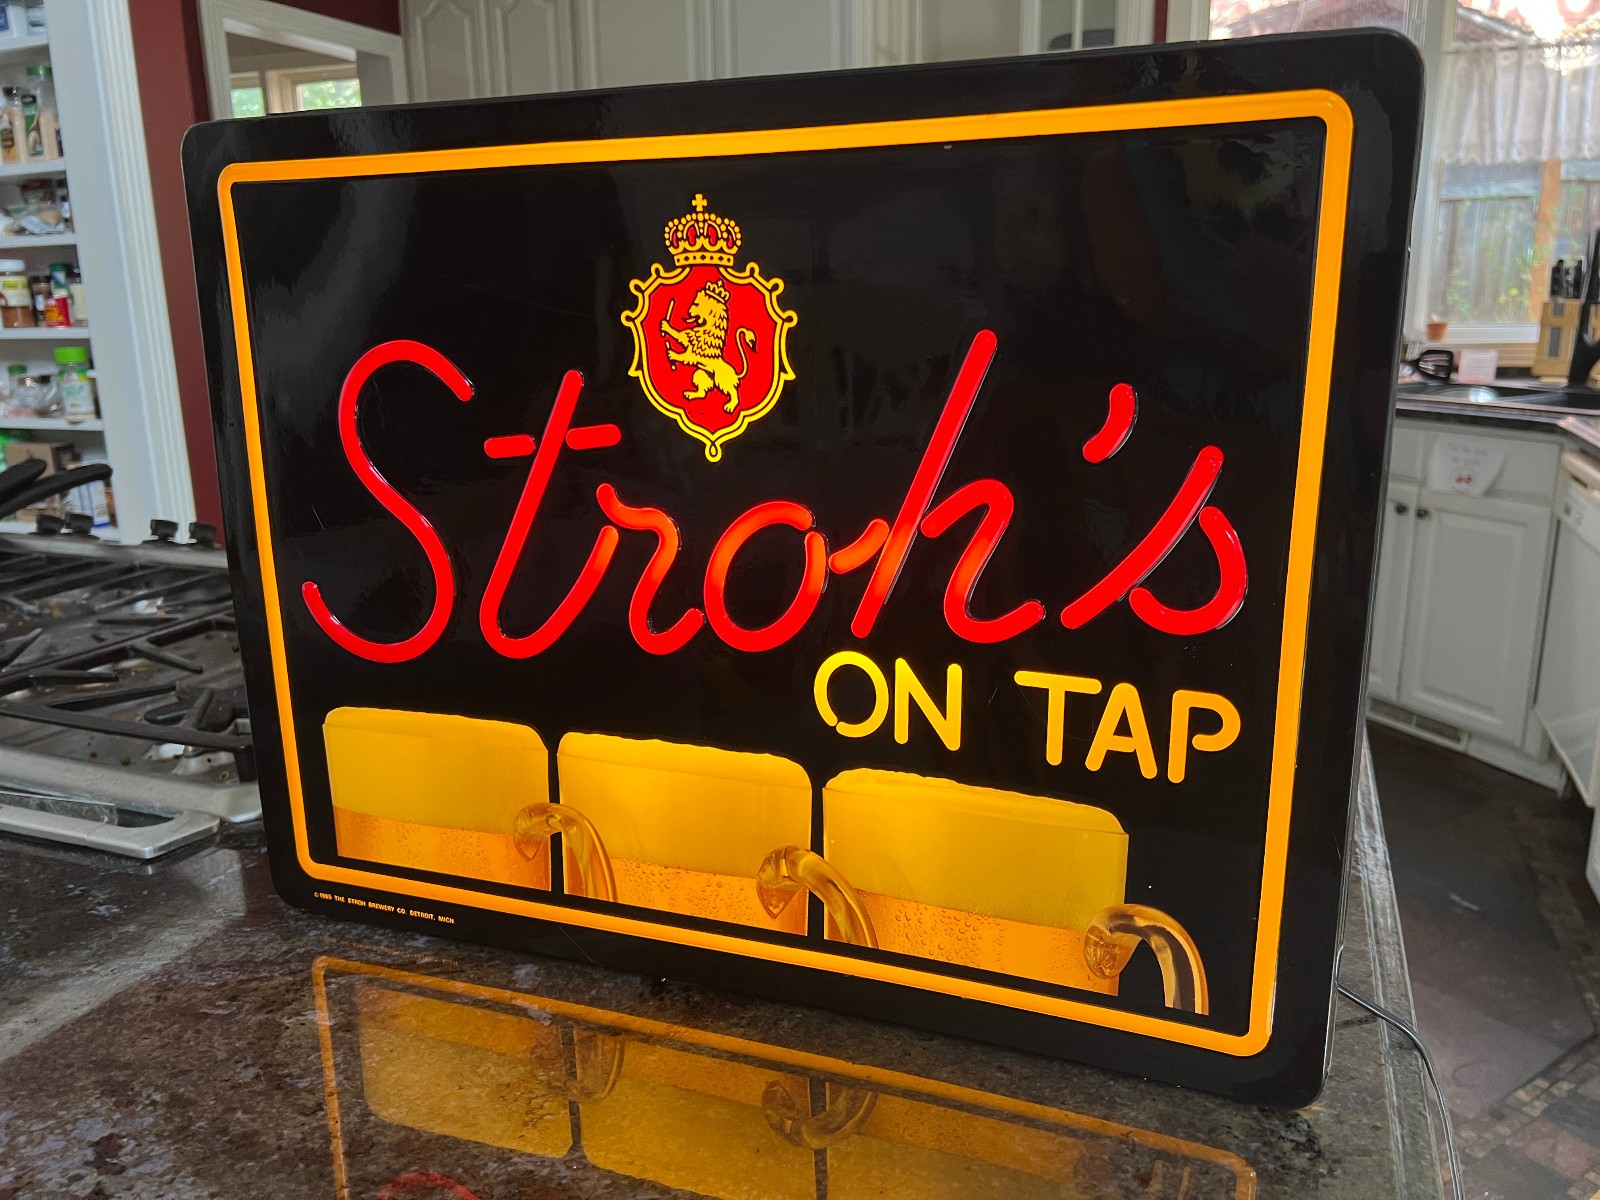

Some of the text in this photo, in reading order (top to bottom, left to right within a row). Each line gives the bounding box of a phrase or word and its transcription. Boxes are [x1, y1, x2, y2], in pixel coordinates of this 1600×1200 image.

[302, 329, 1248, 663] Stroh's
[814, 651, 1241, 784] ON TAP
[334, 895, 345, 903] THE
[347, 898, 366, 907] STROH
[368, 901, 395, 912] BREWERY
